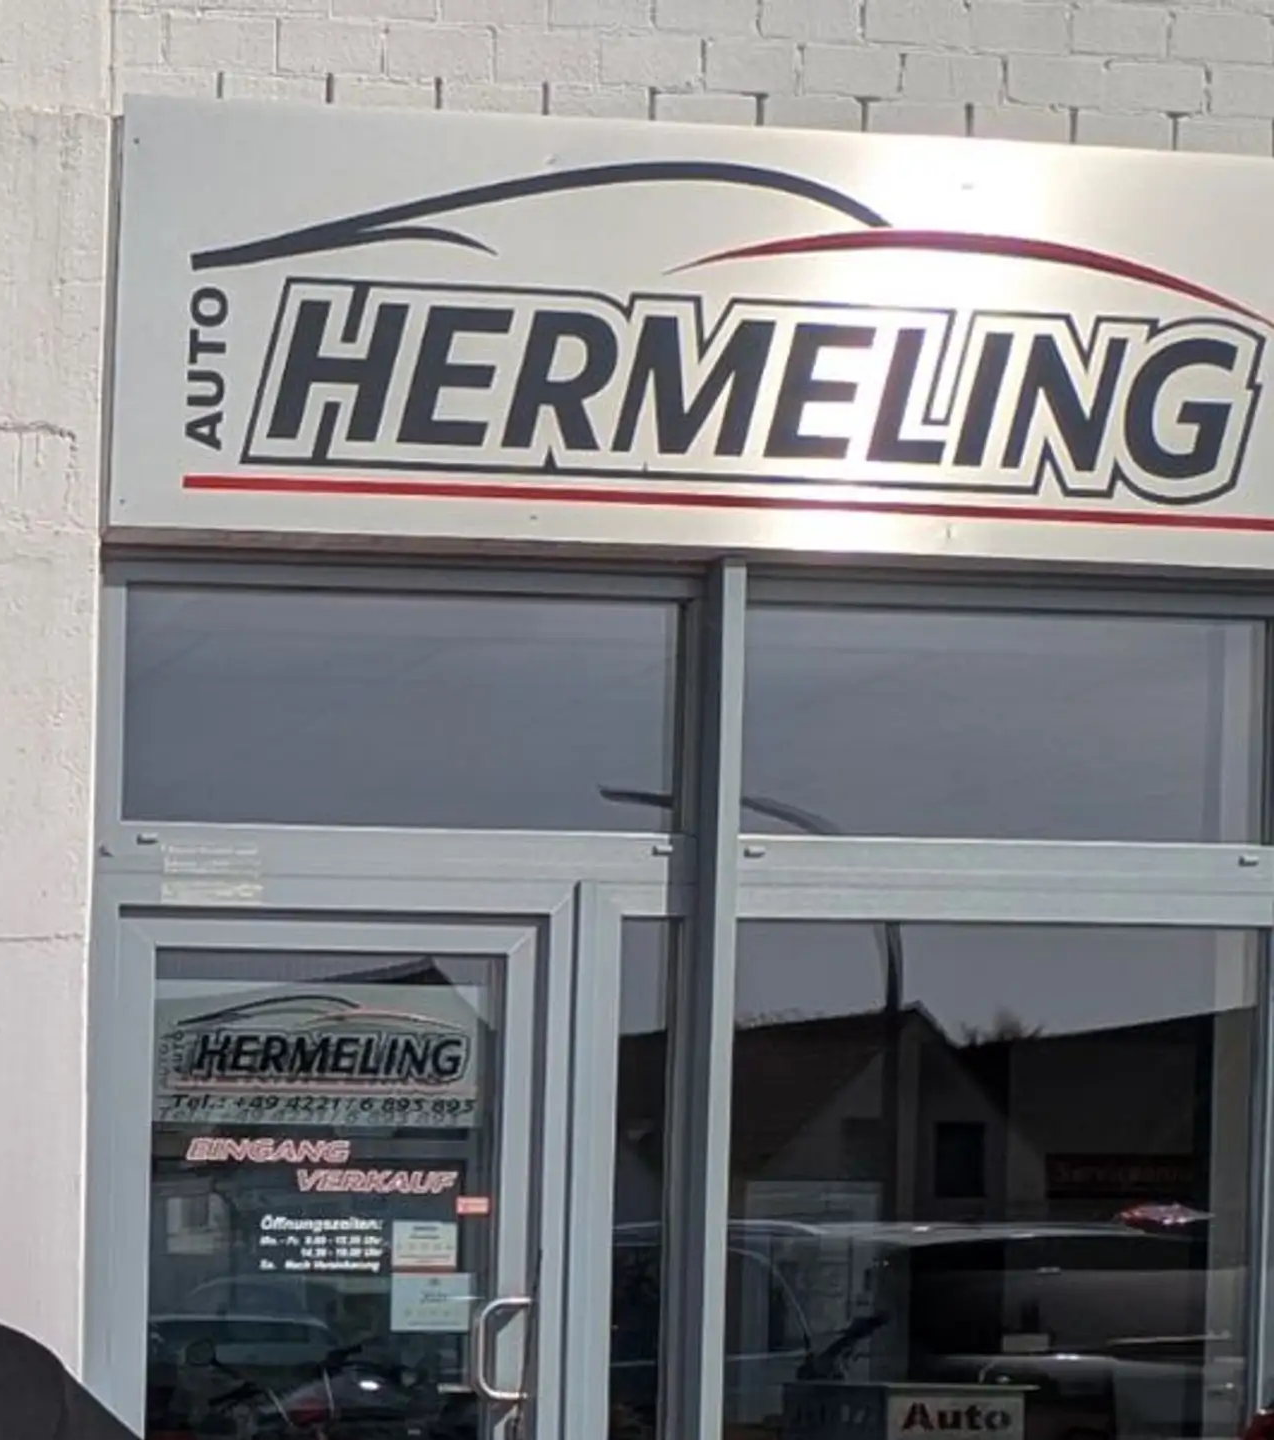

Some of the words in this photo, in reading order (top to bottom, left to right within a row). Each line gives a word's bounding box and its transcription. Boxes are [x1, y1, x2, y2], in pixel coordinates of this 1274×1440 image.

[185, 286, 229, 451] AUTO
[264, 299, 1239, 482] HERMELING
[193, 1033, 463, 1079] HERMELING
[186, 1137, 350, 1164] EINGANG
[296, 1168, 459, 1195] VERKAUF
[902, 1401, 1012, 1432] Auto
